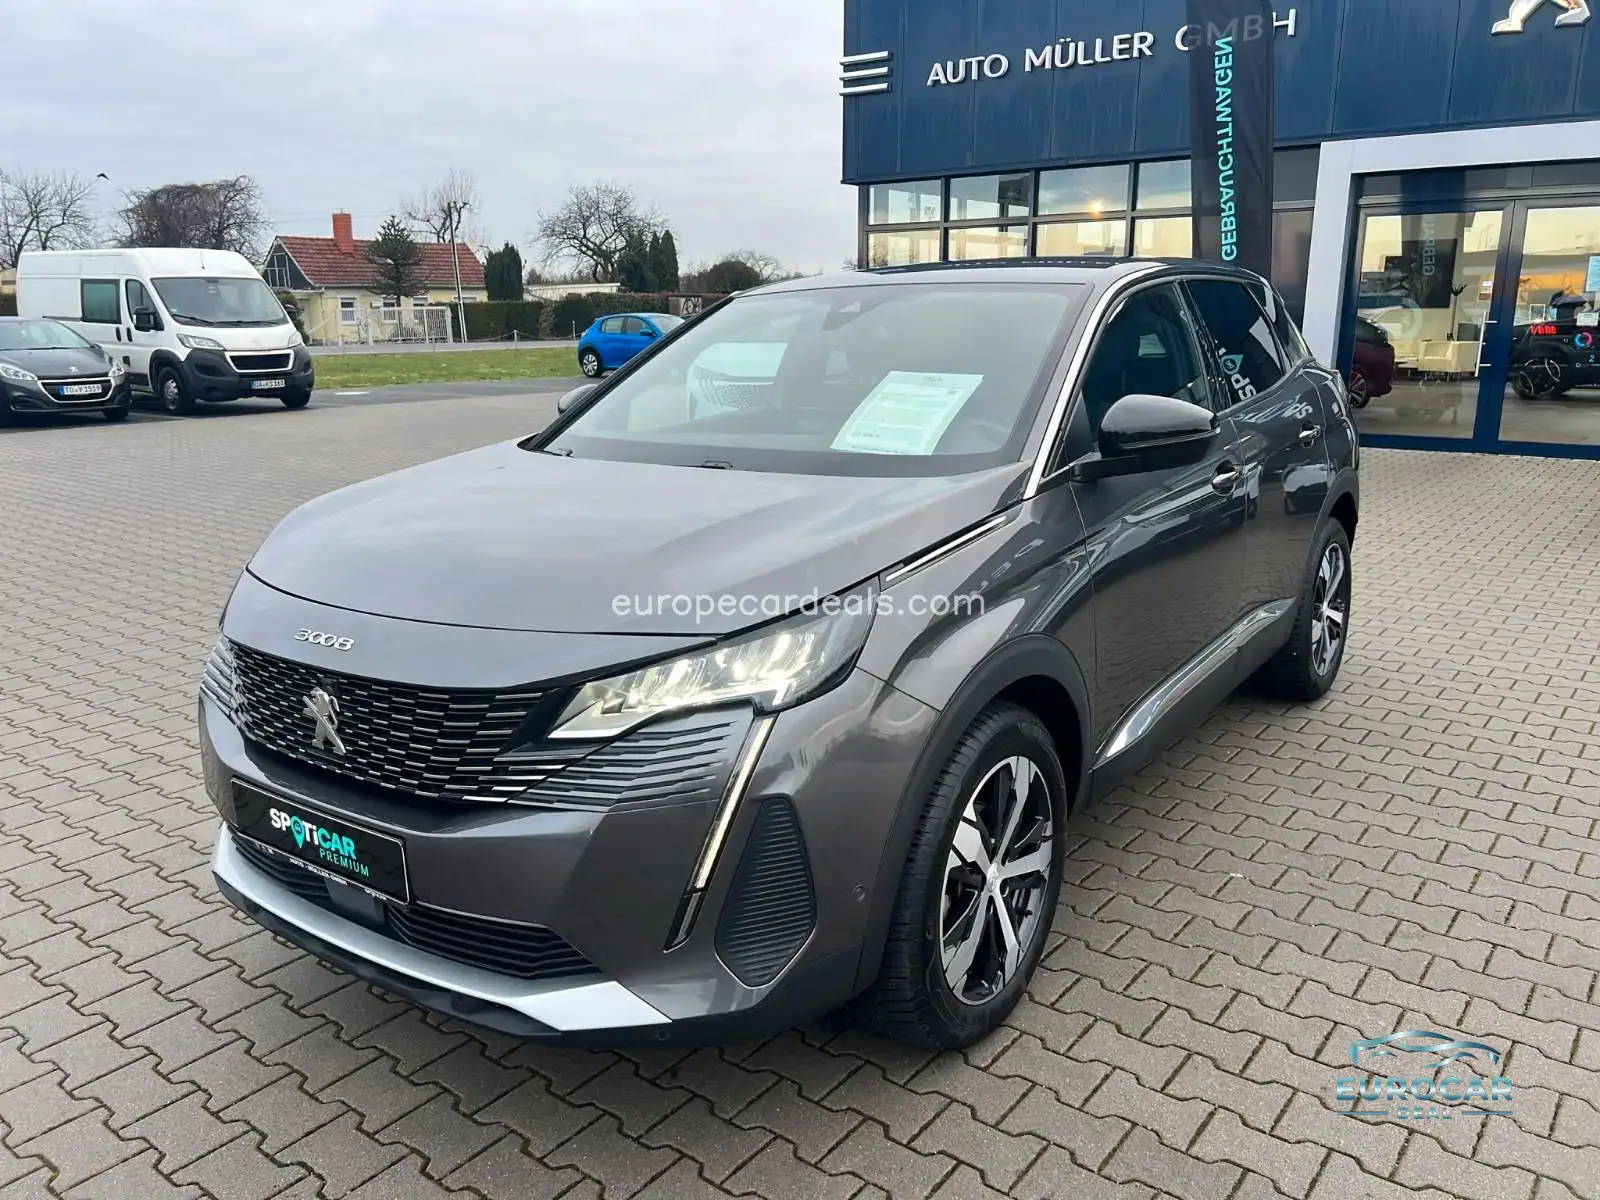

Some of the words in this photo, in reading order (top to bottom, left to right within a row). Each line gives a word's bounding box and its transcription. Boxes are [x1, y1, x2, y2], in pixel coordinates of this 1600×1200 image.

[926, 52, 1009, 87] AUTO
[1023, 31, 1155, 73] MÜLLER
[294, 628, 355, 652] 3008
[319, 847, 370, 878] PREMIUM
